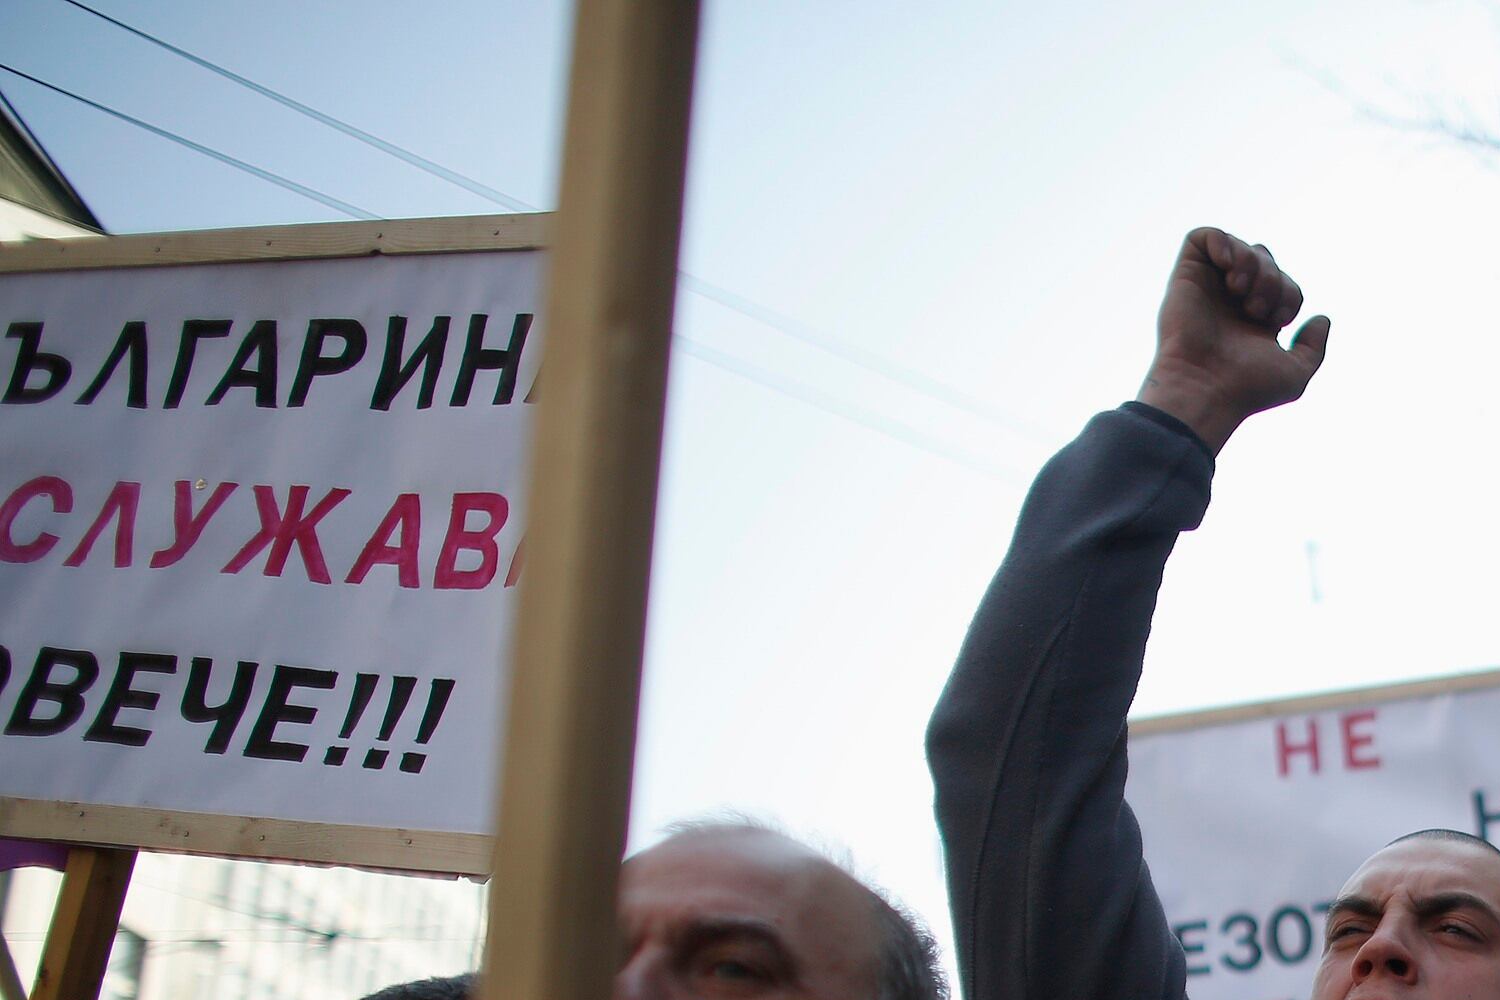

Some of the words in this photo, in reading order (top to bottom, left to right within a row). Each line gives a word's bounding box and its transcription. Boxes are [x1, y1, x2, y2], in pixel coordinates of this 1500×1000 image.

[0, 313, 540, 410] ЪЛГАРИН
[0, 476, 526, 589] СЛУЖАВ
[0, 645, 455, 773] ВЕЧЕ!!!
[1276, 711, 1383, 777] НЕ
